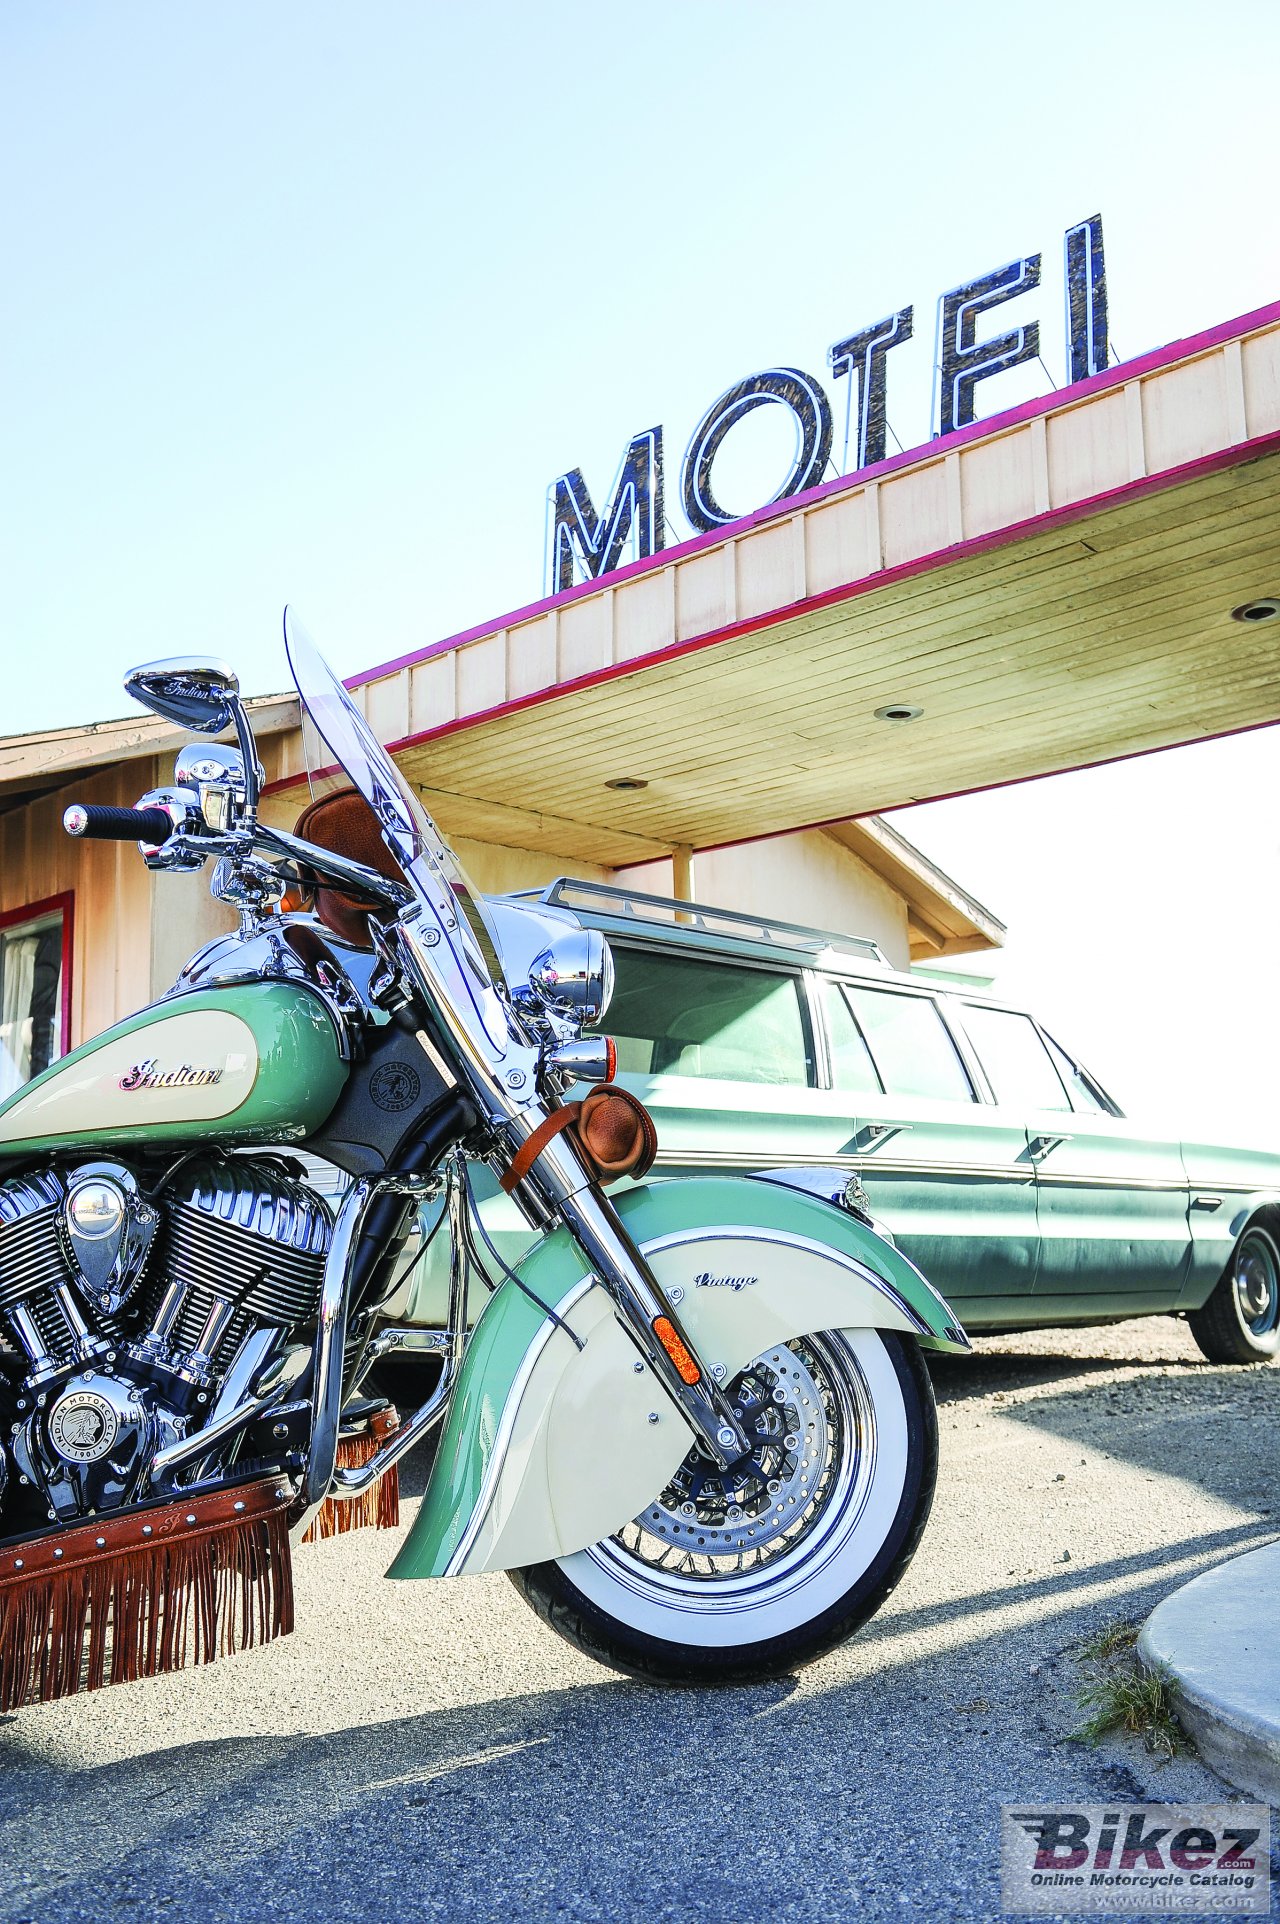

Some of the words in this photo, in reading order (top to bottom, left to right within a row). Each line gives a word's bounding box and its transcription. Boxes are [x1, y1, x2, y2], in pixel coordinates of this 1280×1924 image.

[164, 681, 209, 699] Indian
[119, 1059, 223, 1091] Indian
[694, 1271, 758, 1292] Vintage
[55, 1406, 67, 1447] INDIAN
[70, 1396, 113, 1444] MOTORCYCLE
[74, 1450, 96, 1458] 1901
